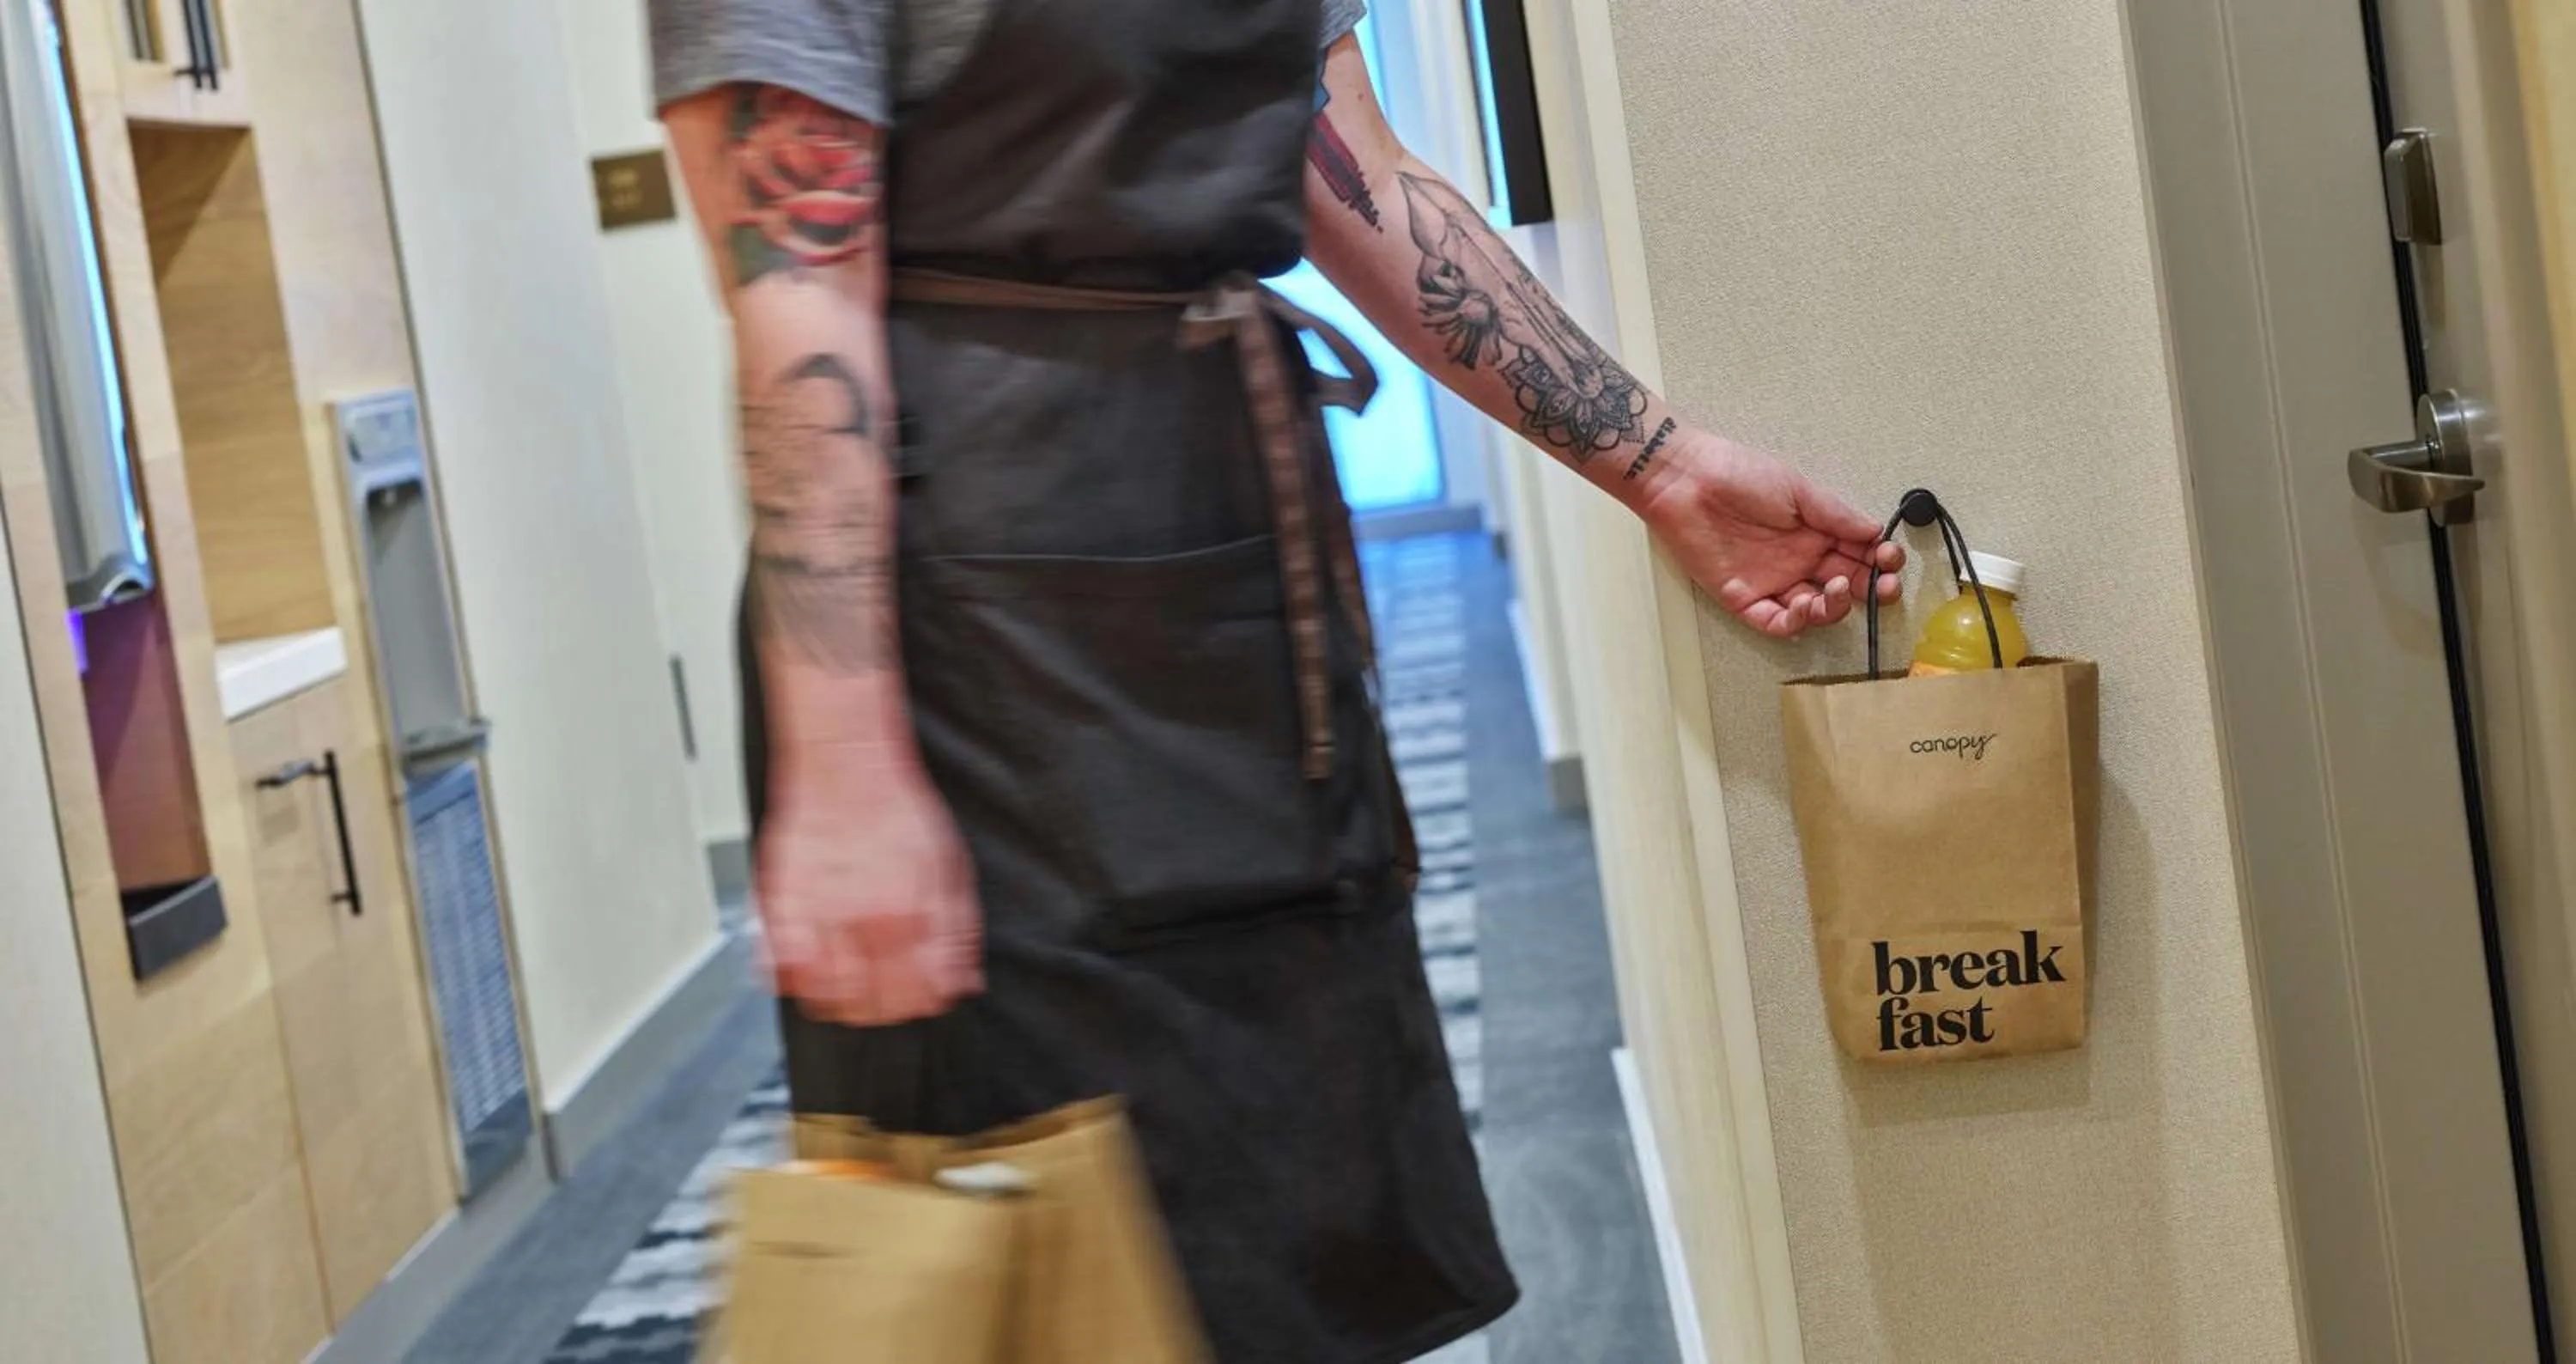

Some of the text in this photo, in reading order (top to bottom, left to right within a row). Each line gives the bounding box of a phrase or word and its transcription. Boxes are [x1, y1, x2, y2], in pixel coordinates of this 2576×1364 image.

[1910, 733, 1997, 760] canopy
[1872, 929, 2067, 996] break
[1876, 996, 1995, 1051] fast
